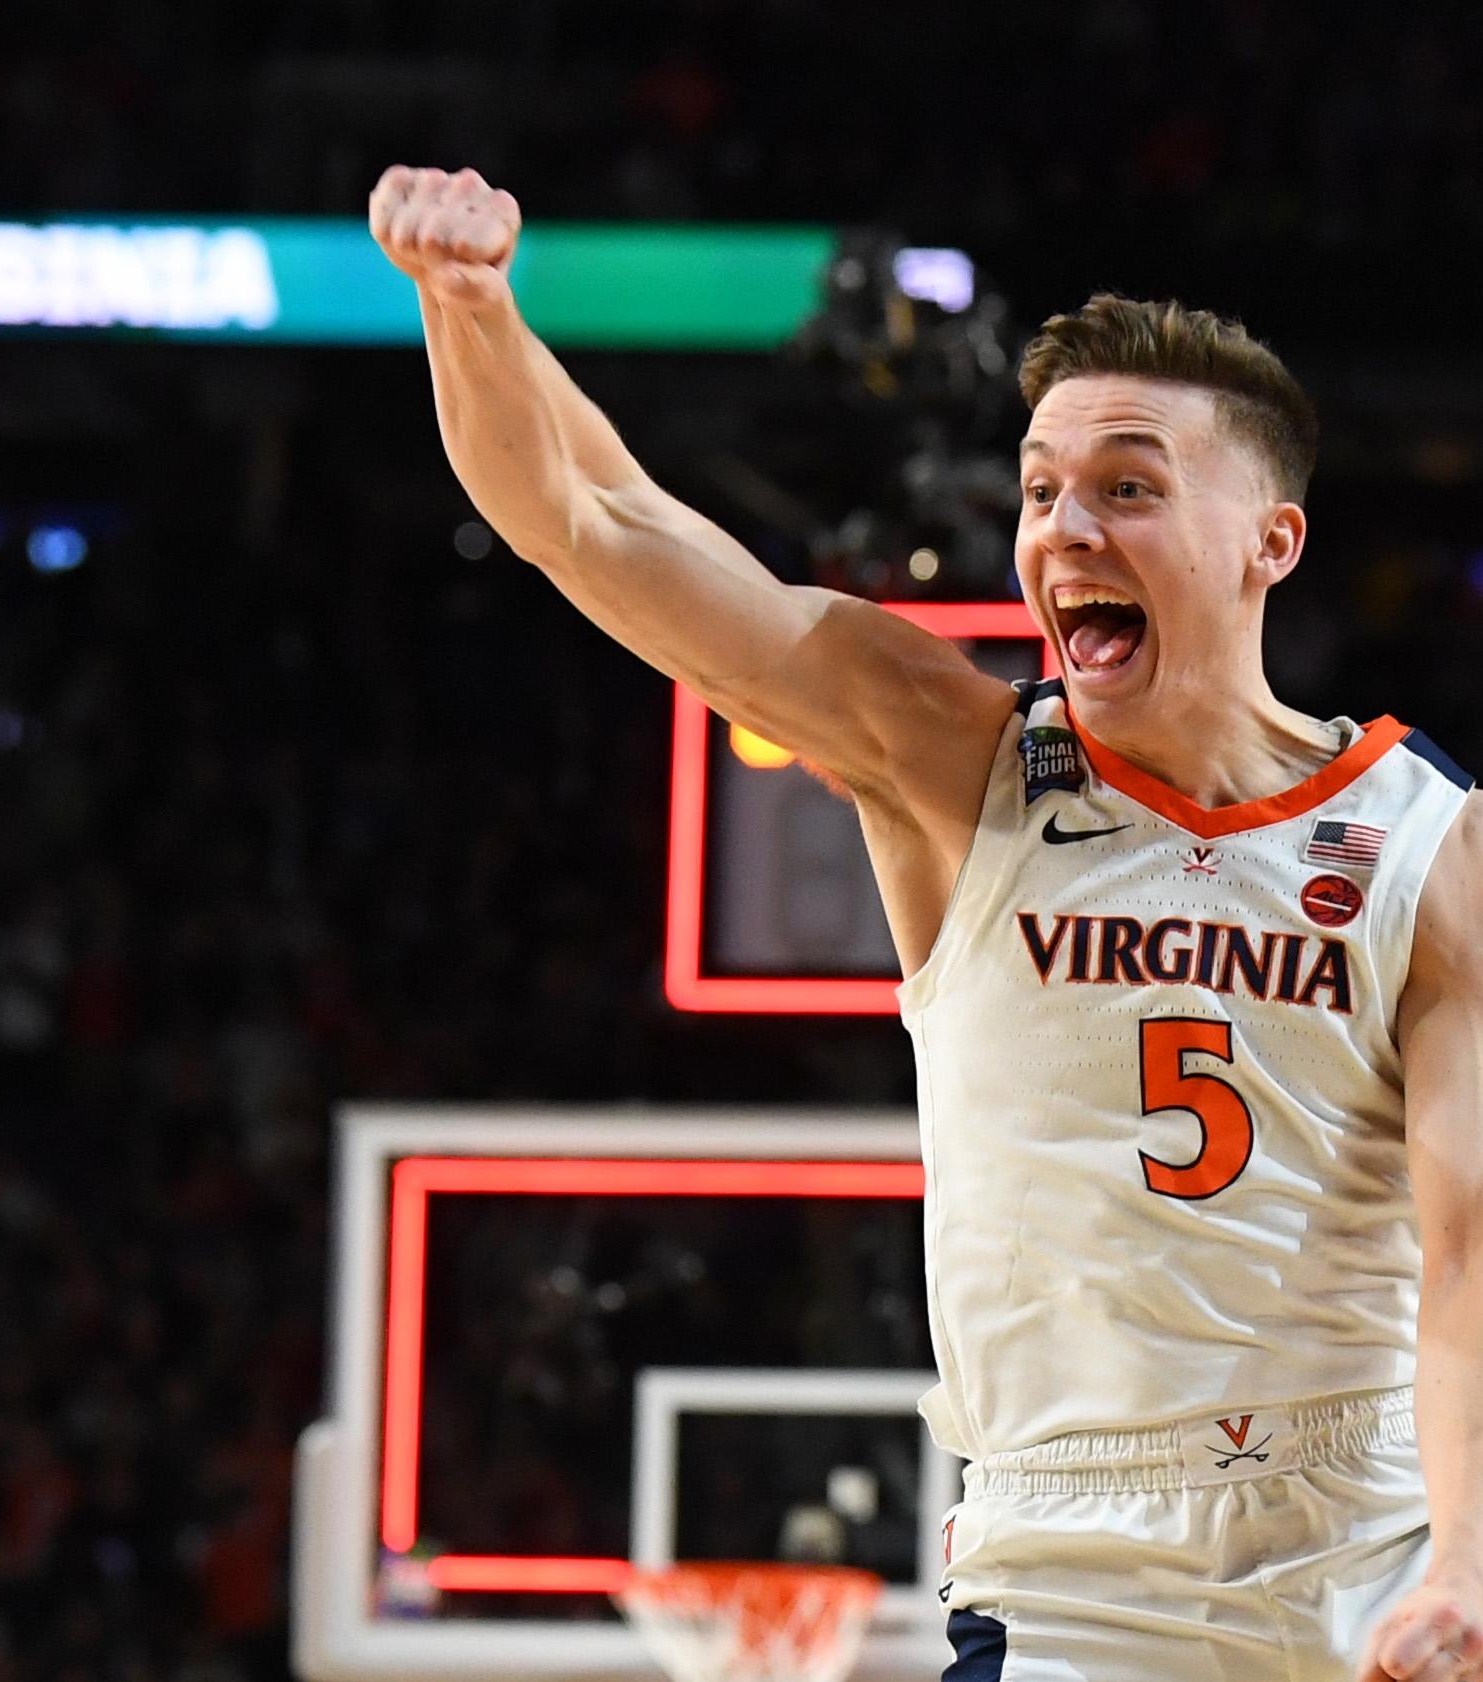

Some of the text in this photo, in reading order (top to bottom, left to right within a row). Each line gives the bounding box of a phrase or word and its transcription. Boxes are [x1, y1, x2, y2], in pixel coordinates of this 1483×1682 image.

[1025, 742, 1076, 766] FINAL
[1026, 756, 1077, 782] FOUR
[1017, 911, 1354, 1015] VIRGINIA
[1137, 1016, 1255, 1201] 5
